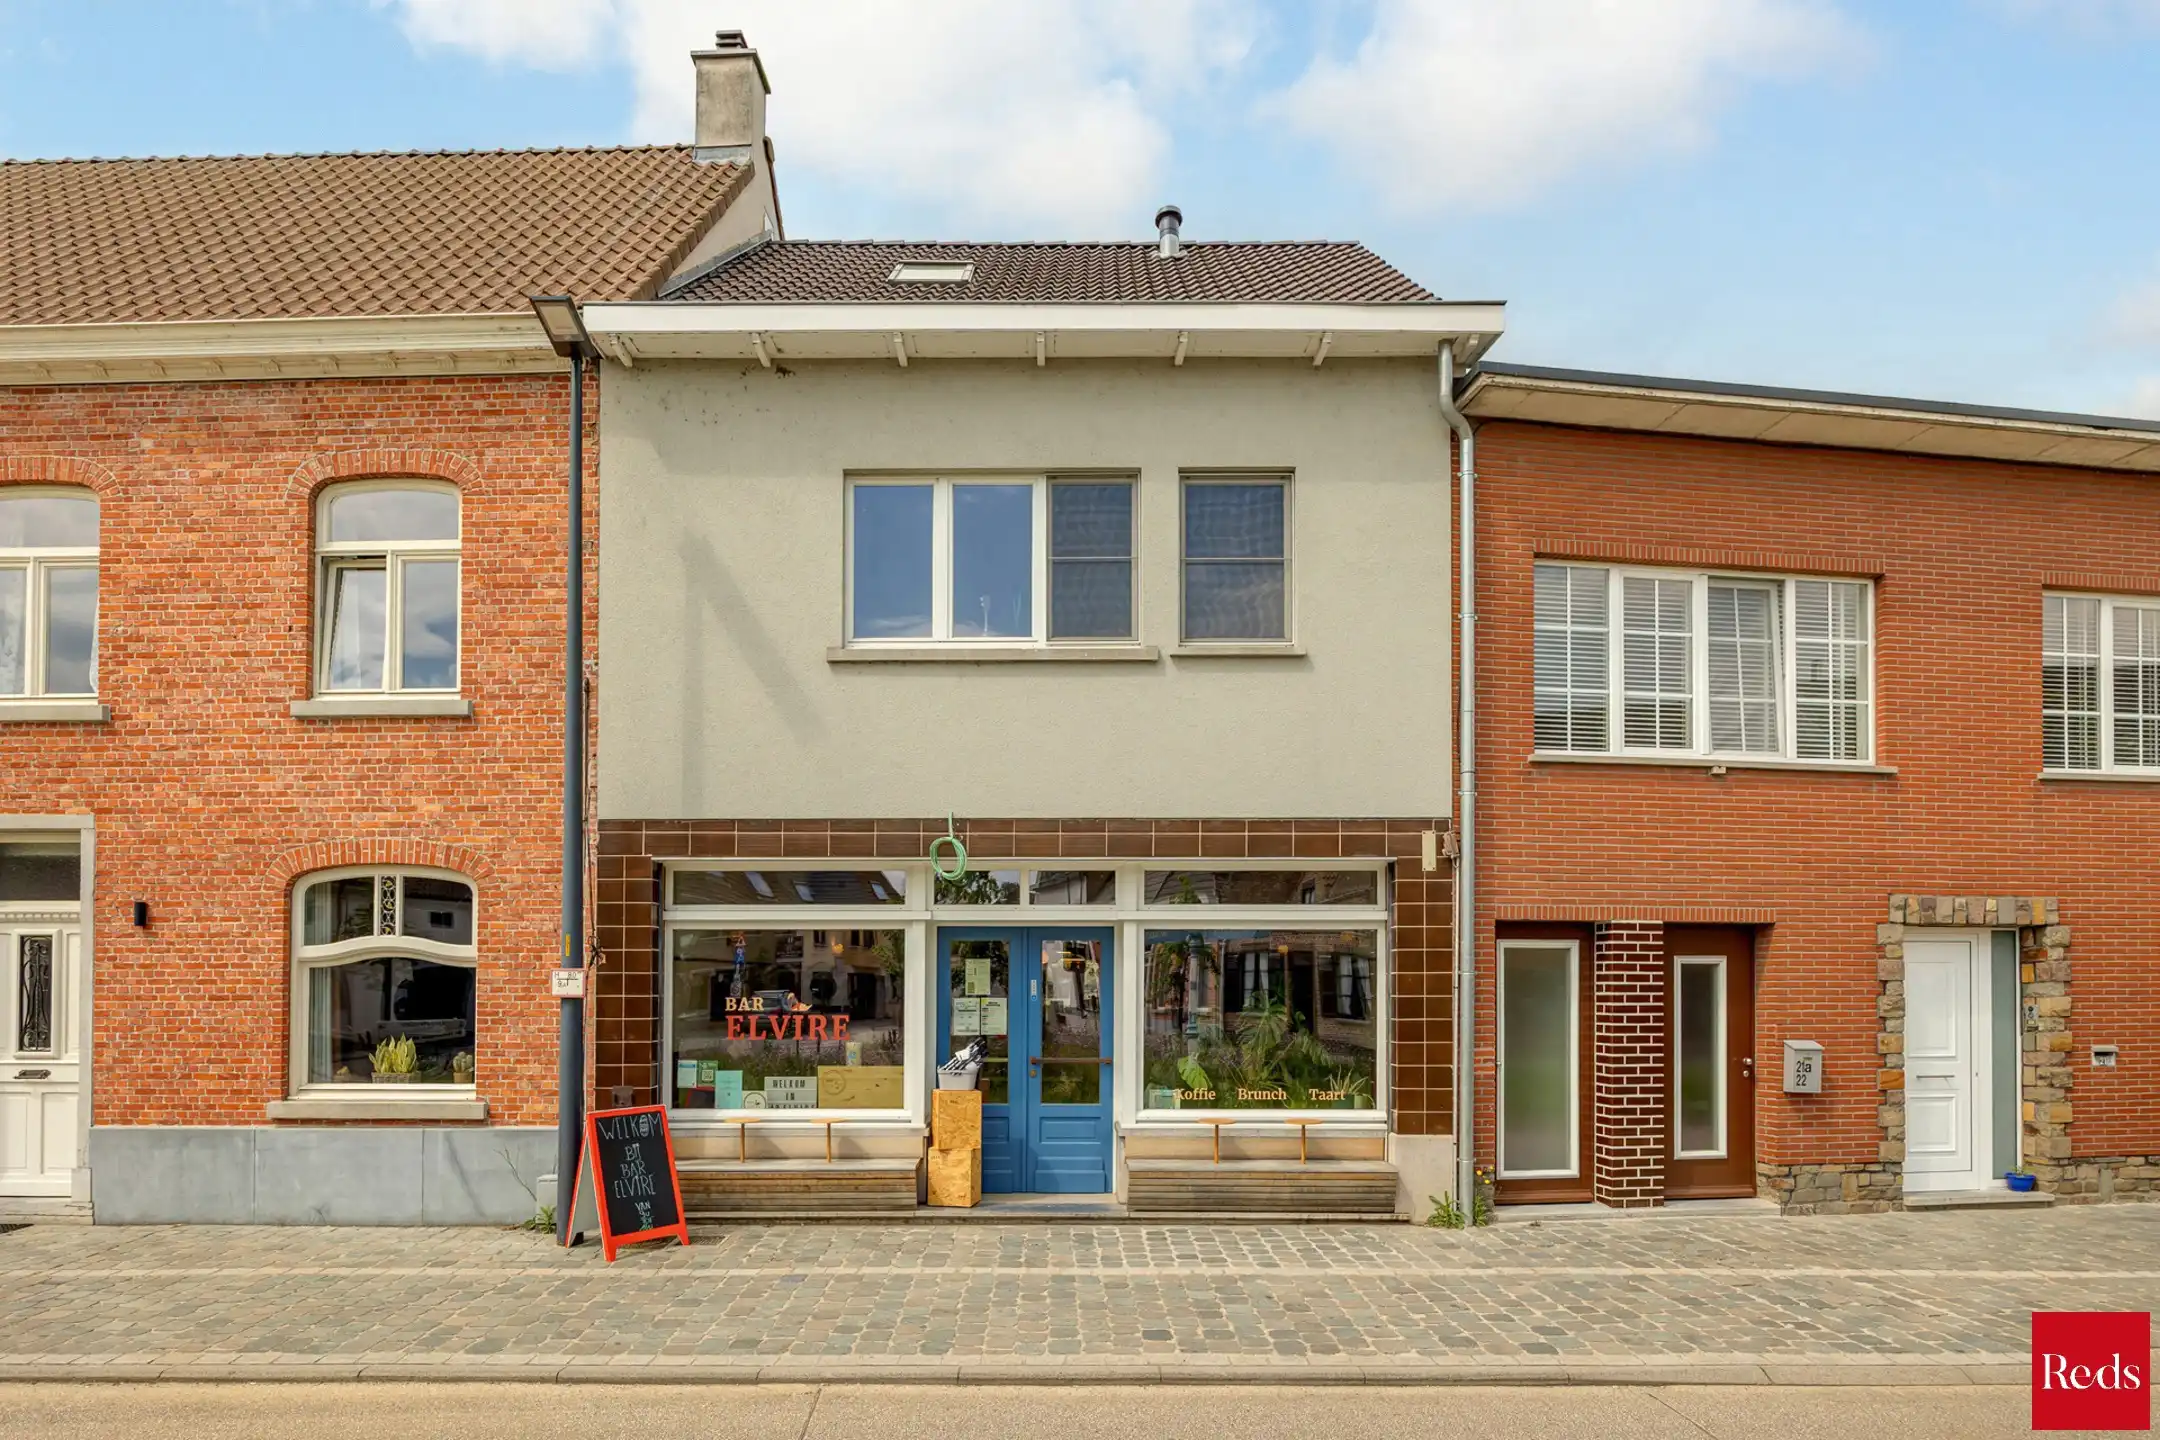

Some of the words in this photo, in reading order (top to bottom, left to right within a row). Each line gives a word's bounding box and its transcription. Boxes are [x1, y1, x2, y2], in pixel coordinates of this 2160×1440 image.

[725, 997, 765, 1012] BAR
[725, 1014, 850, 1041] ELVIRE
[1796, 1060, 1812, 1073] 21a
[1796, 1074, 1807, 1086] 22
[785, 1092, 795, 1101] IN
[1175, 1088, 1216, 1101] Koffie
[1238, 1087, 1287, 1100] Brunch
[1309, 1088, 1346, 1100] Taart
[597, 1112, 664, 1140] WELKOM
[619, 1160, 647, 1179] BAR
[613, 1173, 657, 1199] ELVIRE
